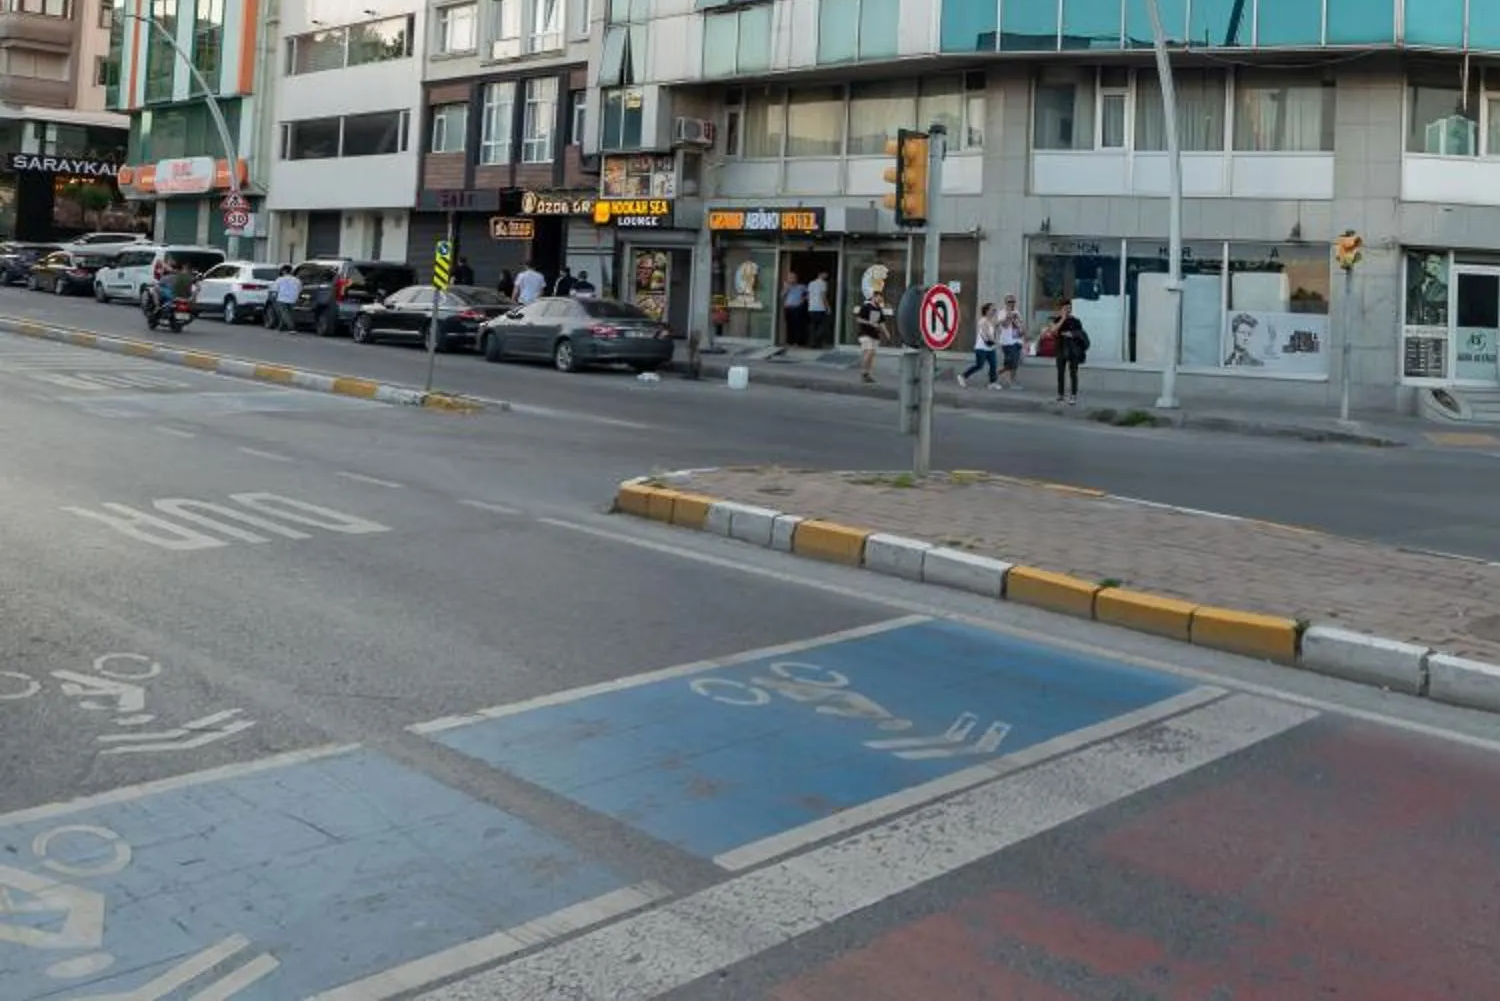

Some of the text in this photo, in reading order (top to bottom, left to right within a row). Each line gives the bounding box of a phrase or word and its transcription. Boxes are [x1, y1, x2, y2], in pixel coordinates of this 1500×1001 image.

[12, 155, 124, 177] SARAYKAL
[650, 200, 669, 214] SEA
[617, 216, 660, 226] LOUNGE
[782, 212, 819, 230] HOTEL
[58, 492, 392, 550] DUR
